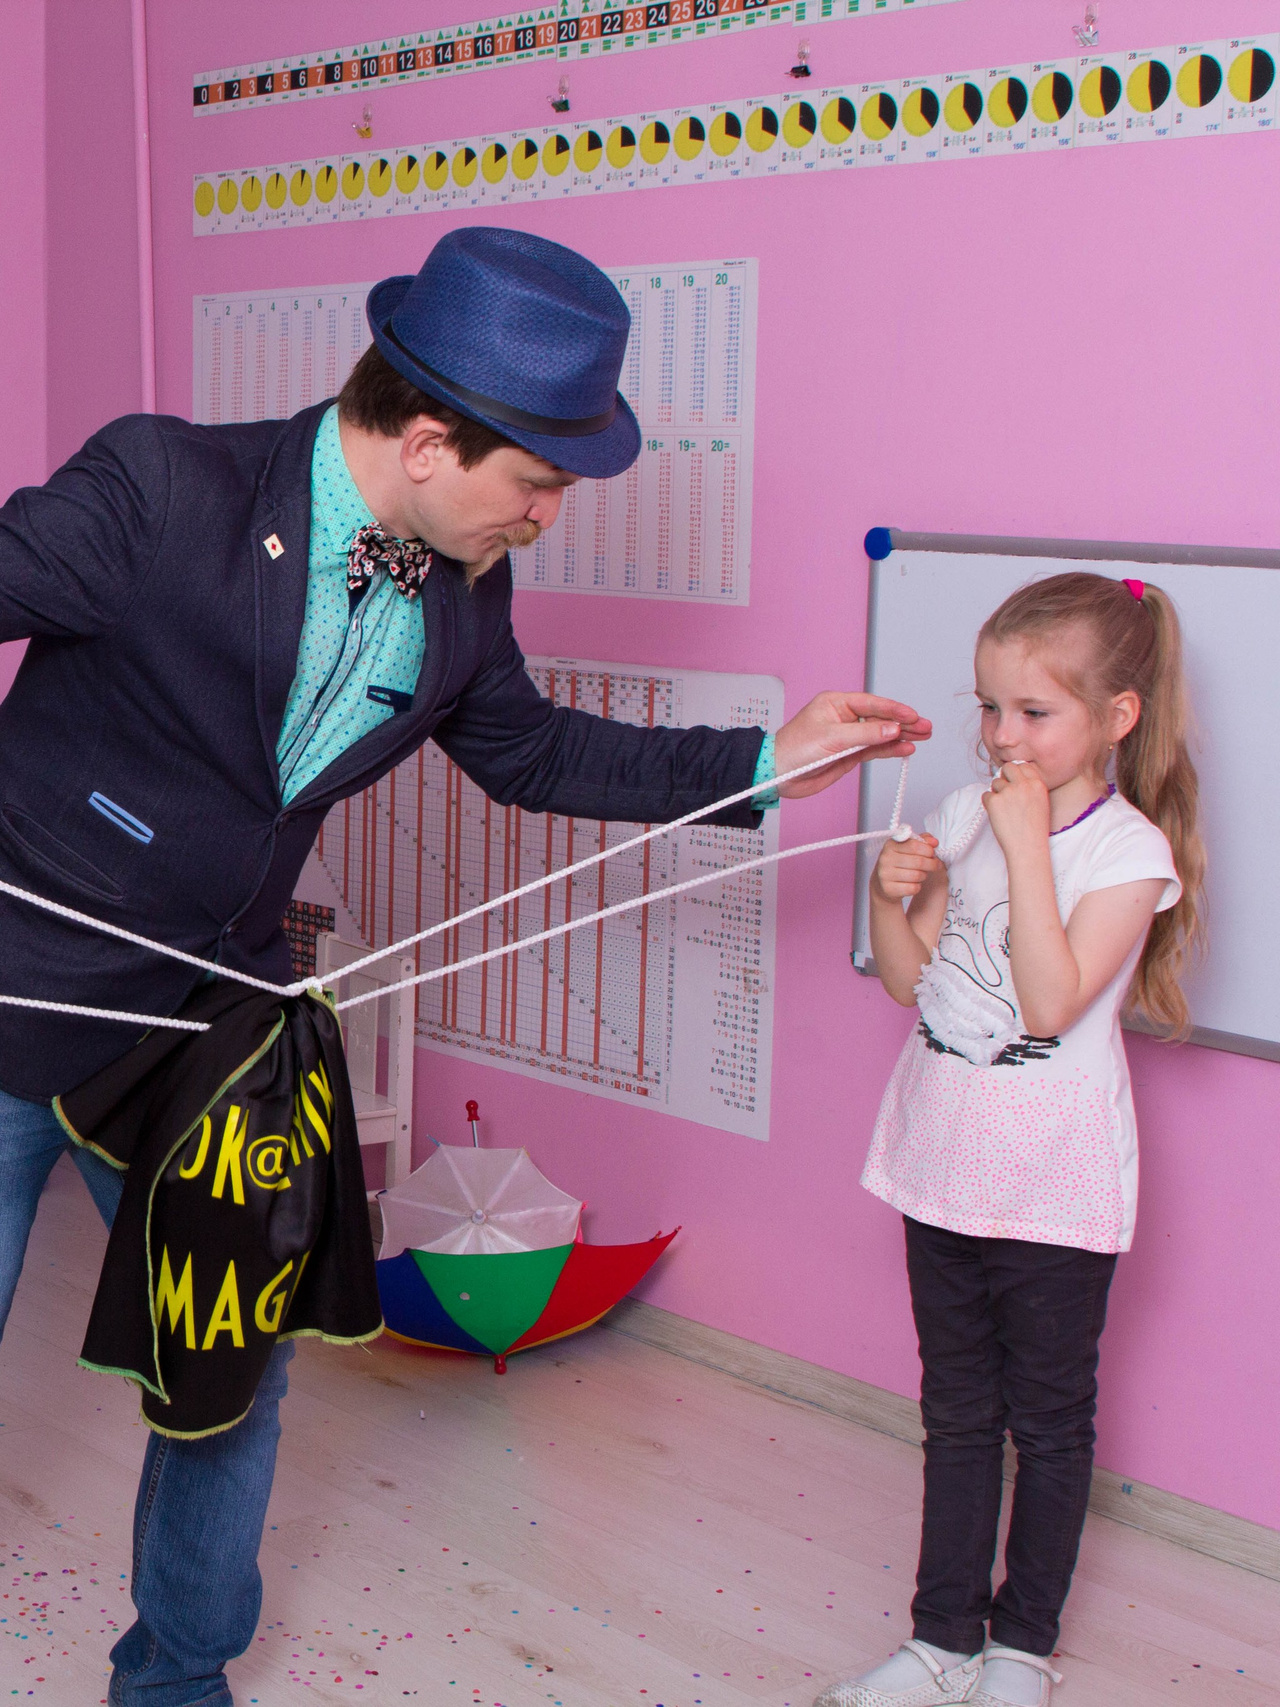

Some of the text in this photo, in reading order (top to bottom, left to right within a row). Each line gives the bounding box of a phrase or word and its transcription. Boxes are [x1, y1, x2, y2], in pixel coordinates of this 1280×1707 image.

[201, 88, 207, 103] 0
[217, 84, 222, 99] 1
[232, 83, 239, 98] 2
[249, 79, 255, 95] 3
[265, 77, 272, 93] 4
[282, 74, 289, 89] 5
[299, 71, 306, 86] 6
[316, 68, 323, 84] 7
[333, 65, 341, 81] 8
[351, 62, 358, 78] 9
[363, 60, 377, 77] 10
[380, 56, 394, 73] 11
[399, 52, 414, 70] 12
[418, 50, 433, 66] 13
[437, 46, 453, 64] 14
[456, 42, 472, 60] 15
[476, 38, 492, 55] 16
[496, 34, 513, 52] 17
[517, 29, 534, 48] 18
[538, 26, 555, 45] 19
[559, 21, 577, 41] 20
[581, 18, 597, 37] 21
[603, 14, 621, 34] 22
[625, 11, 644, 30] 23
[648, 6, 667, 26] 24
[672, 2, 691, 22] 25
[696, 0, 715, 17] 26
[204, 273, 728, 317] 1 2 3 4 5 6 7 17 18 19 20
